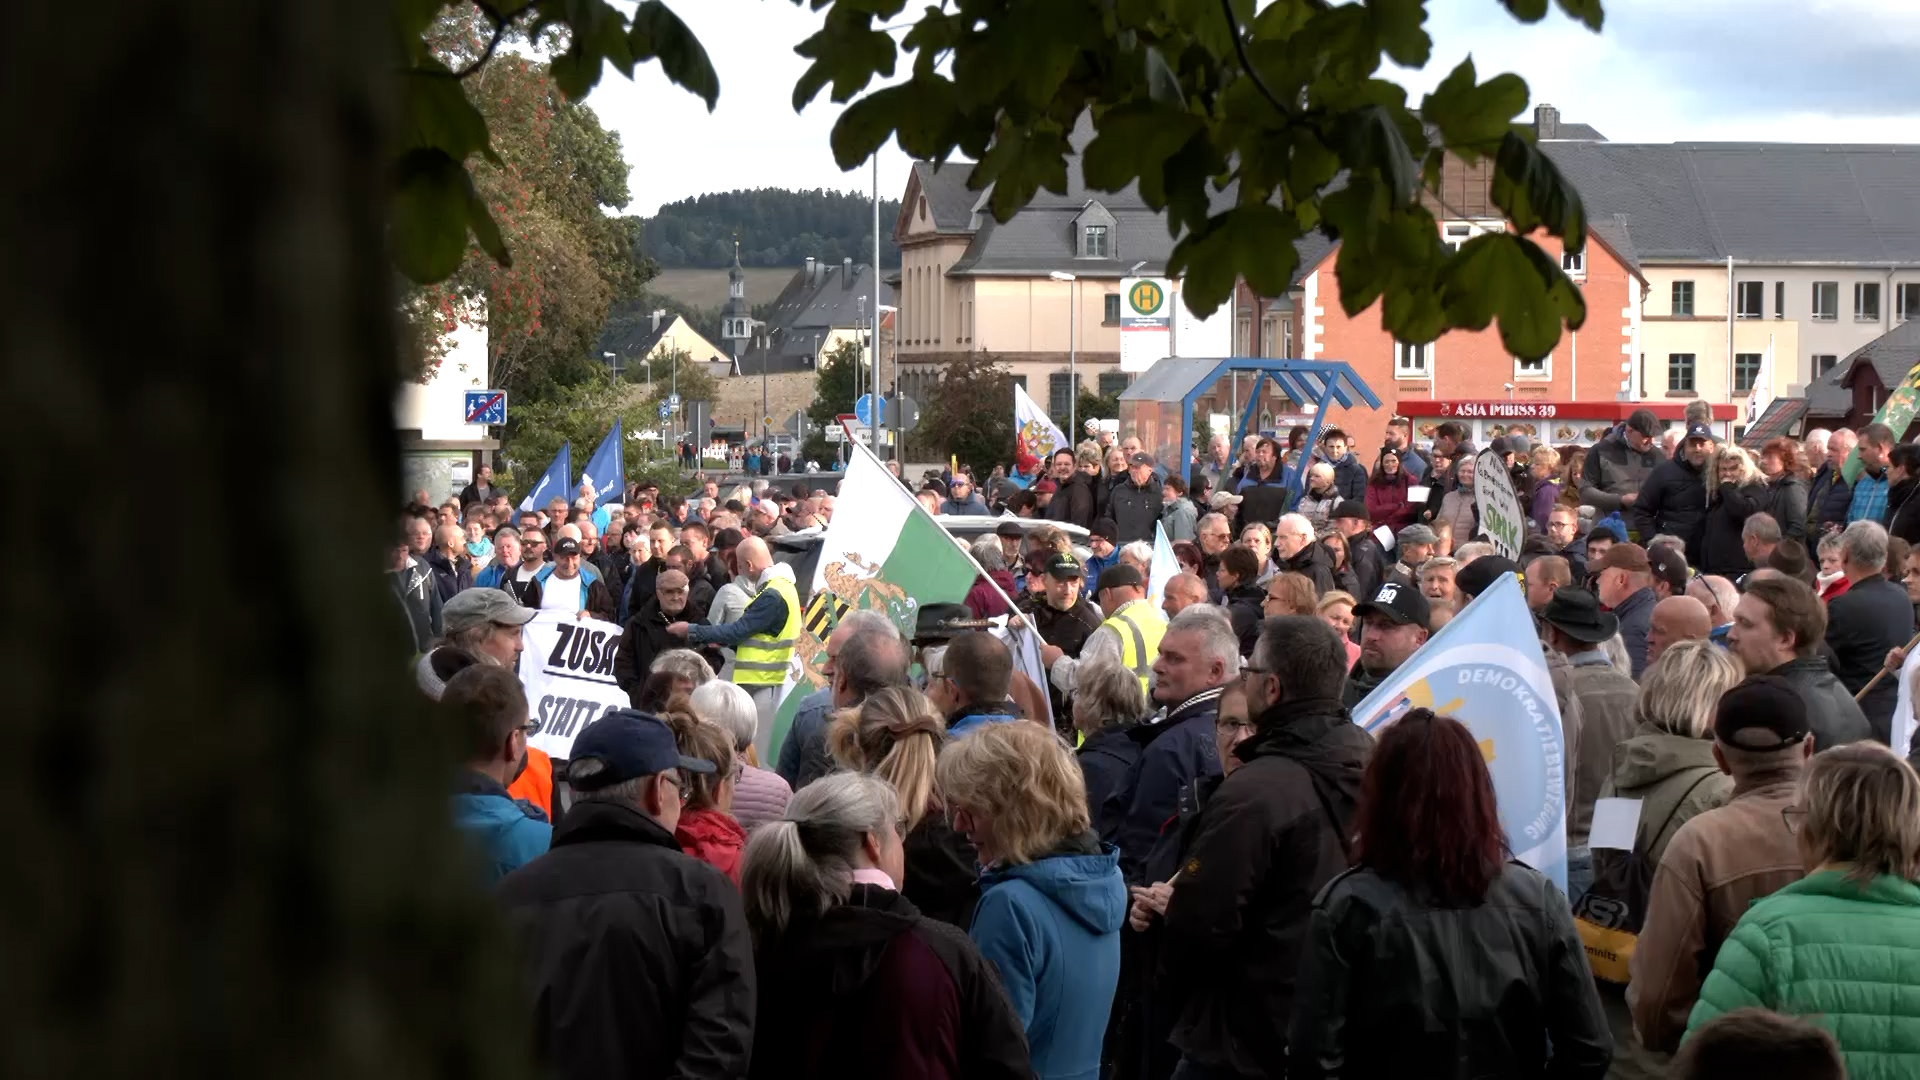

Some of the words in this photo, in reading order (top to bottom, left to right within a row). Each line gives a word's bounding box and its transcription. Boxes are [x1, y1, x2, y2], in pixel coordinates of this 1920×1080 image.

[1139, 285, 1154, 308] H
[1455, 403, 1487, 417] ASIA
[1489, 404, 1536, 417] IMBISS
[548, 622, 621, 676] ZUSA
[527, 694, 602, 738] STATT
